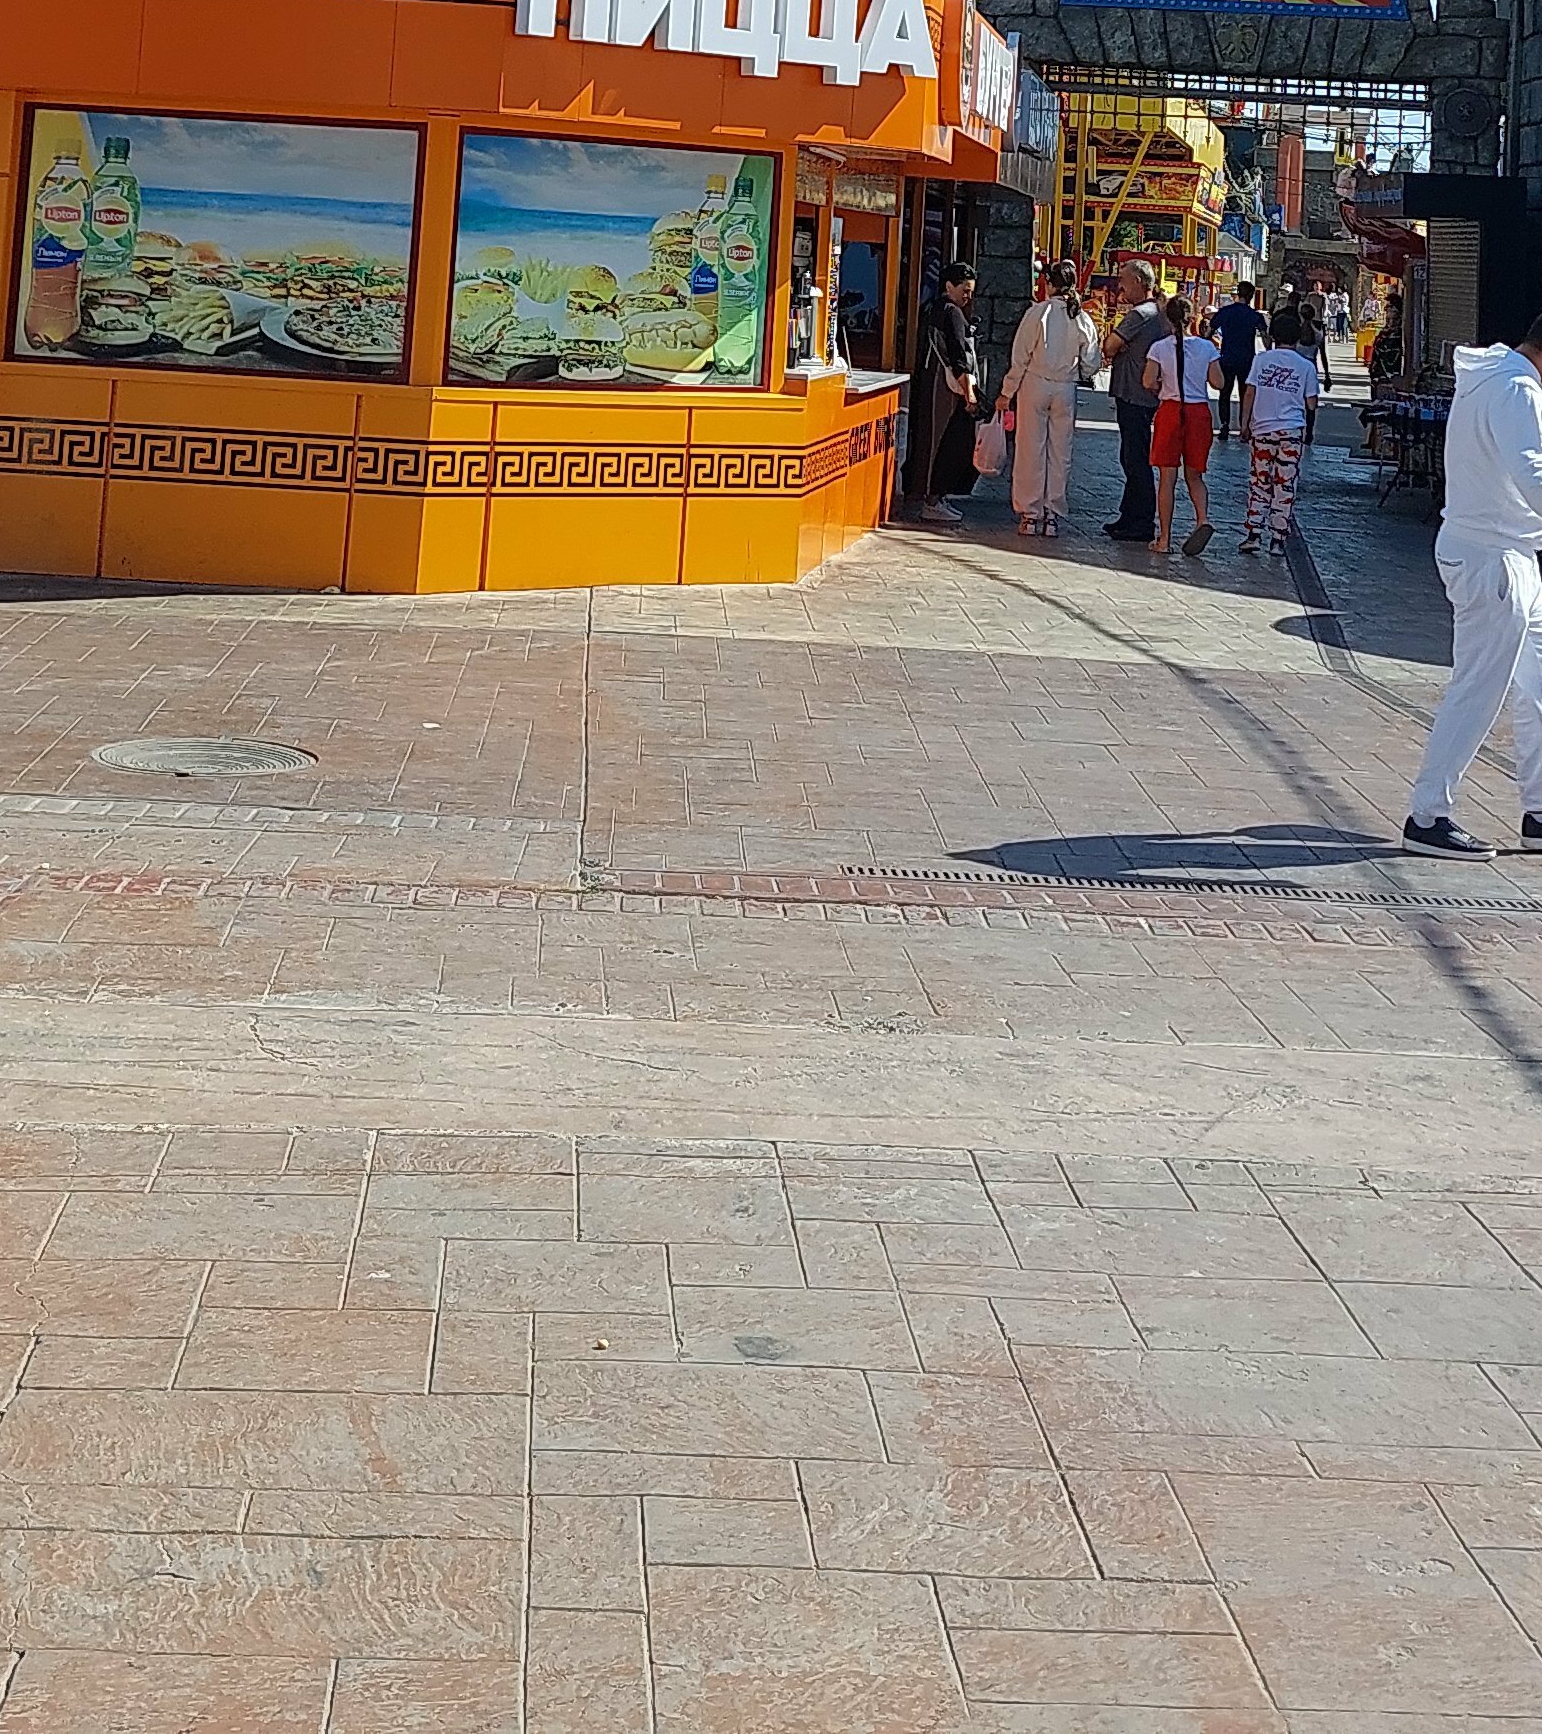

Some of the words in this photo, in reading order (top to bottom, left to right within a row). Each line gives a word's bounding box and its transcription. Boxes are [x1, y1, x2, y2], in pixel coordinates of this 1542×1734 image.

[47, 209, 79, 222] Lipton
[95, 211, 128, 223] Lipton
[728, 247, 753, 259] Lipton
